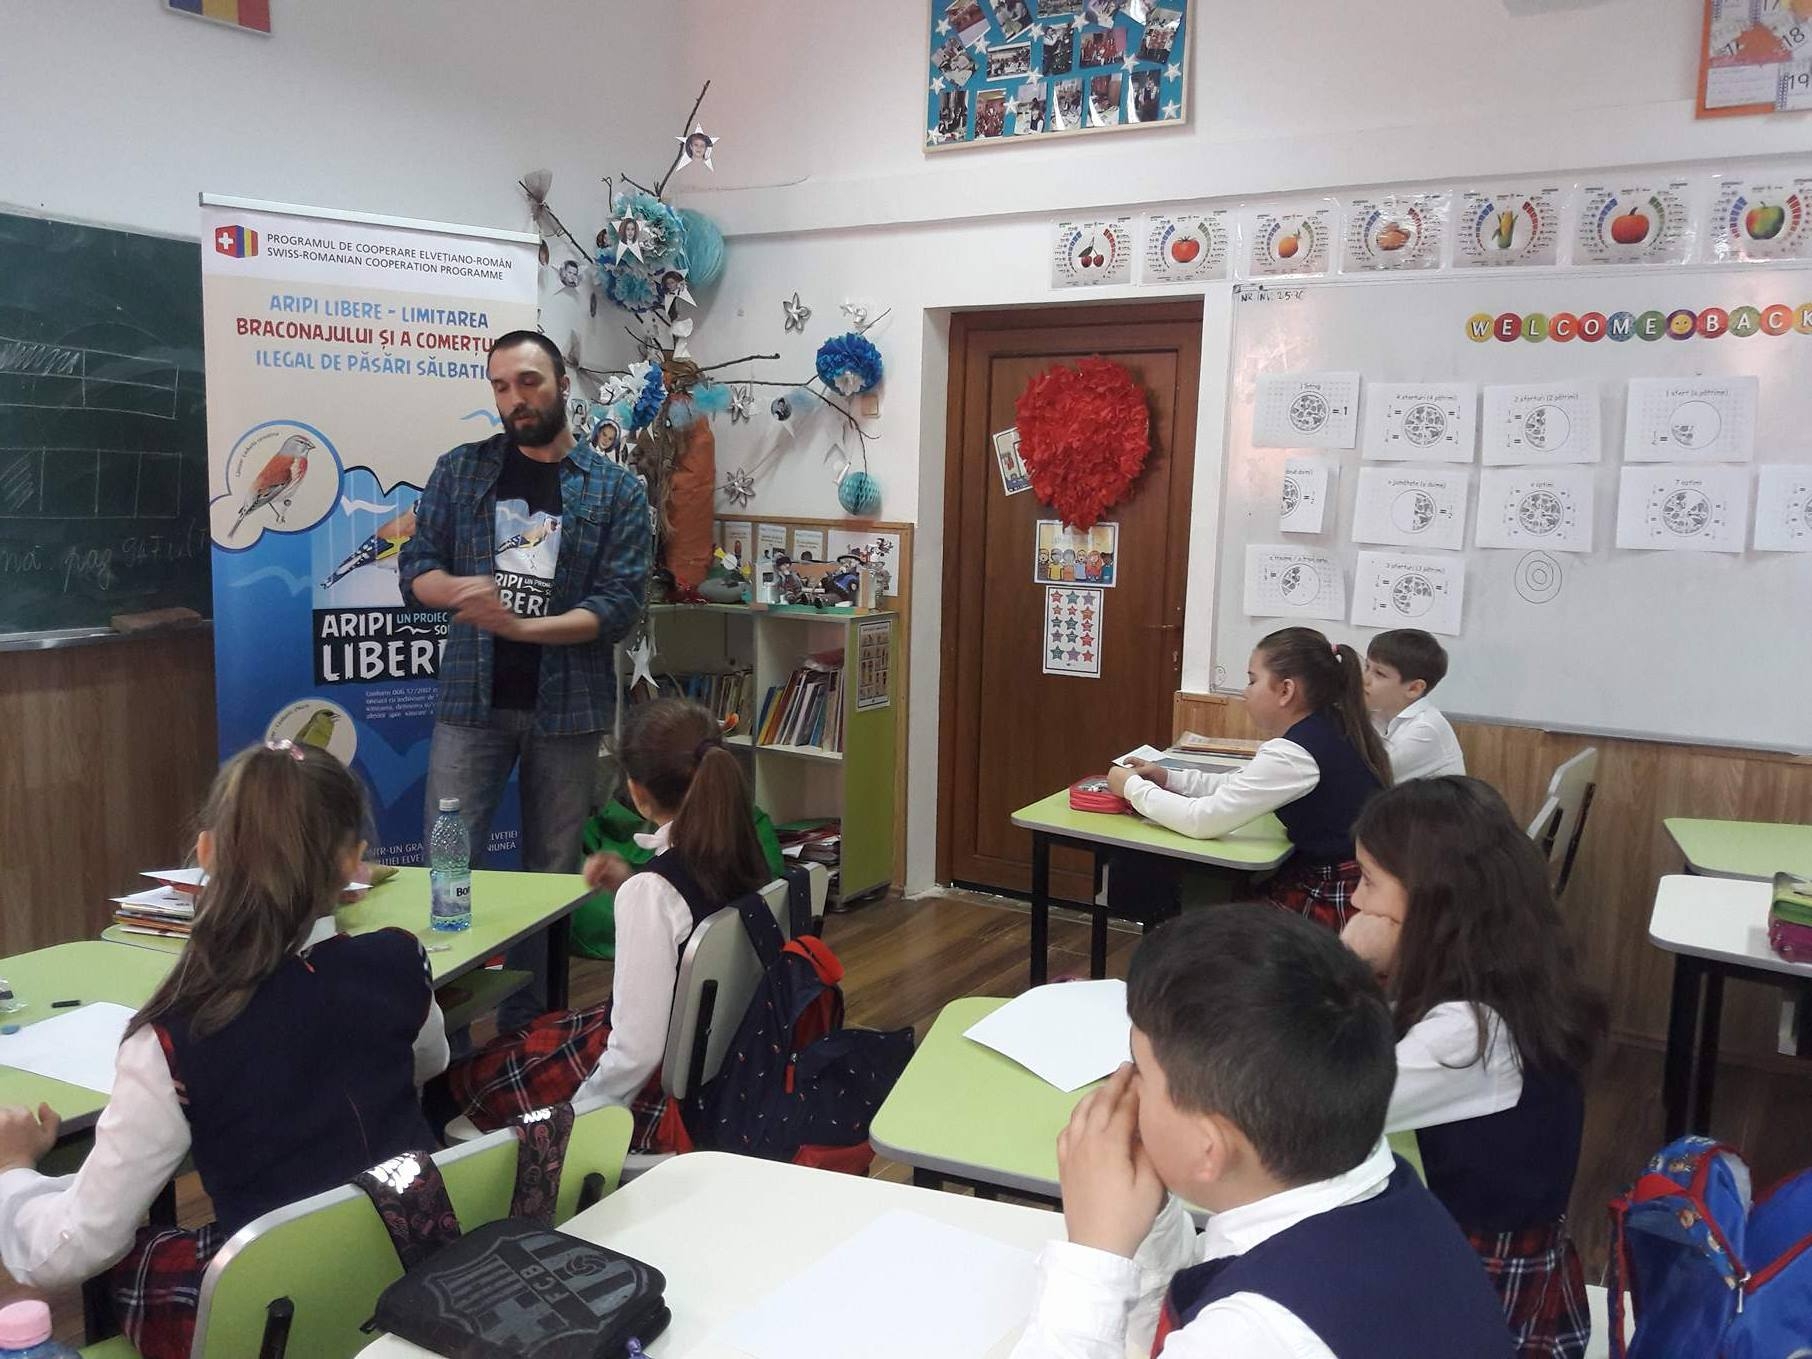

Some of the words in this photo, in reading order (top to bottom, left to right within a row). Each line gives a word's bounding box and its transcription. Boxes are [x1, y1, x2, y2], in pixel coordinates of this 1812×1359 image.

[1782, 26, 1806, 49] 18
[1787, 72, 1810, 90] 19
[267, 233, 336, 250] PROGRAMUL
[339, 241, 353, 252] DE
[355, 243, 417, 259] COOPERARE
[267, 247, 363, 266] SWISS-ROMANIAN
[365, 257, 438, 273] COOPERATION
[440, 265, 504, 281] PROGRAMME
[270, 294, 319, 315] ARIPI
[325, 299, 383, 320] LIBERE
[402, 306, 489, 329] LIMITAREA
[1470, 314, 1658, 338] WELCOME
[1705, 308, 1812, 334] BACK
[236, 317, 374, 344] BRACONAJULUI
[379, 329, 395, 351] ȘI
[400, 331, 412, 347] A
[416, 332, 497, 357] COMERȚU
[256, 350, 316, 370] ILEGAL
[321, 353, 342, 371] DE
[347, 350, 411, 375] PĂSĂRI
[416, 356, 490, 380] SĂLBATI
[494, 572, 524, 589] RIPI
[499, 589, 550, 617] BER
[322, 612, 393, 639] ARIPI
[396, 613, 411, 625] UN
[413, 612, 448, 624] PROIEC
[434, 624, 450, 636] SO
[405, 842, 424, 853] GRA
